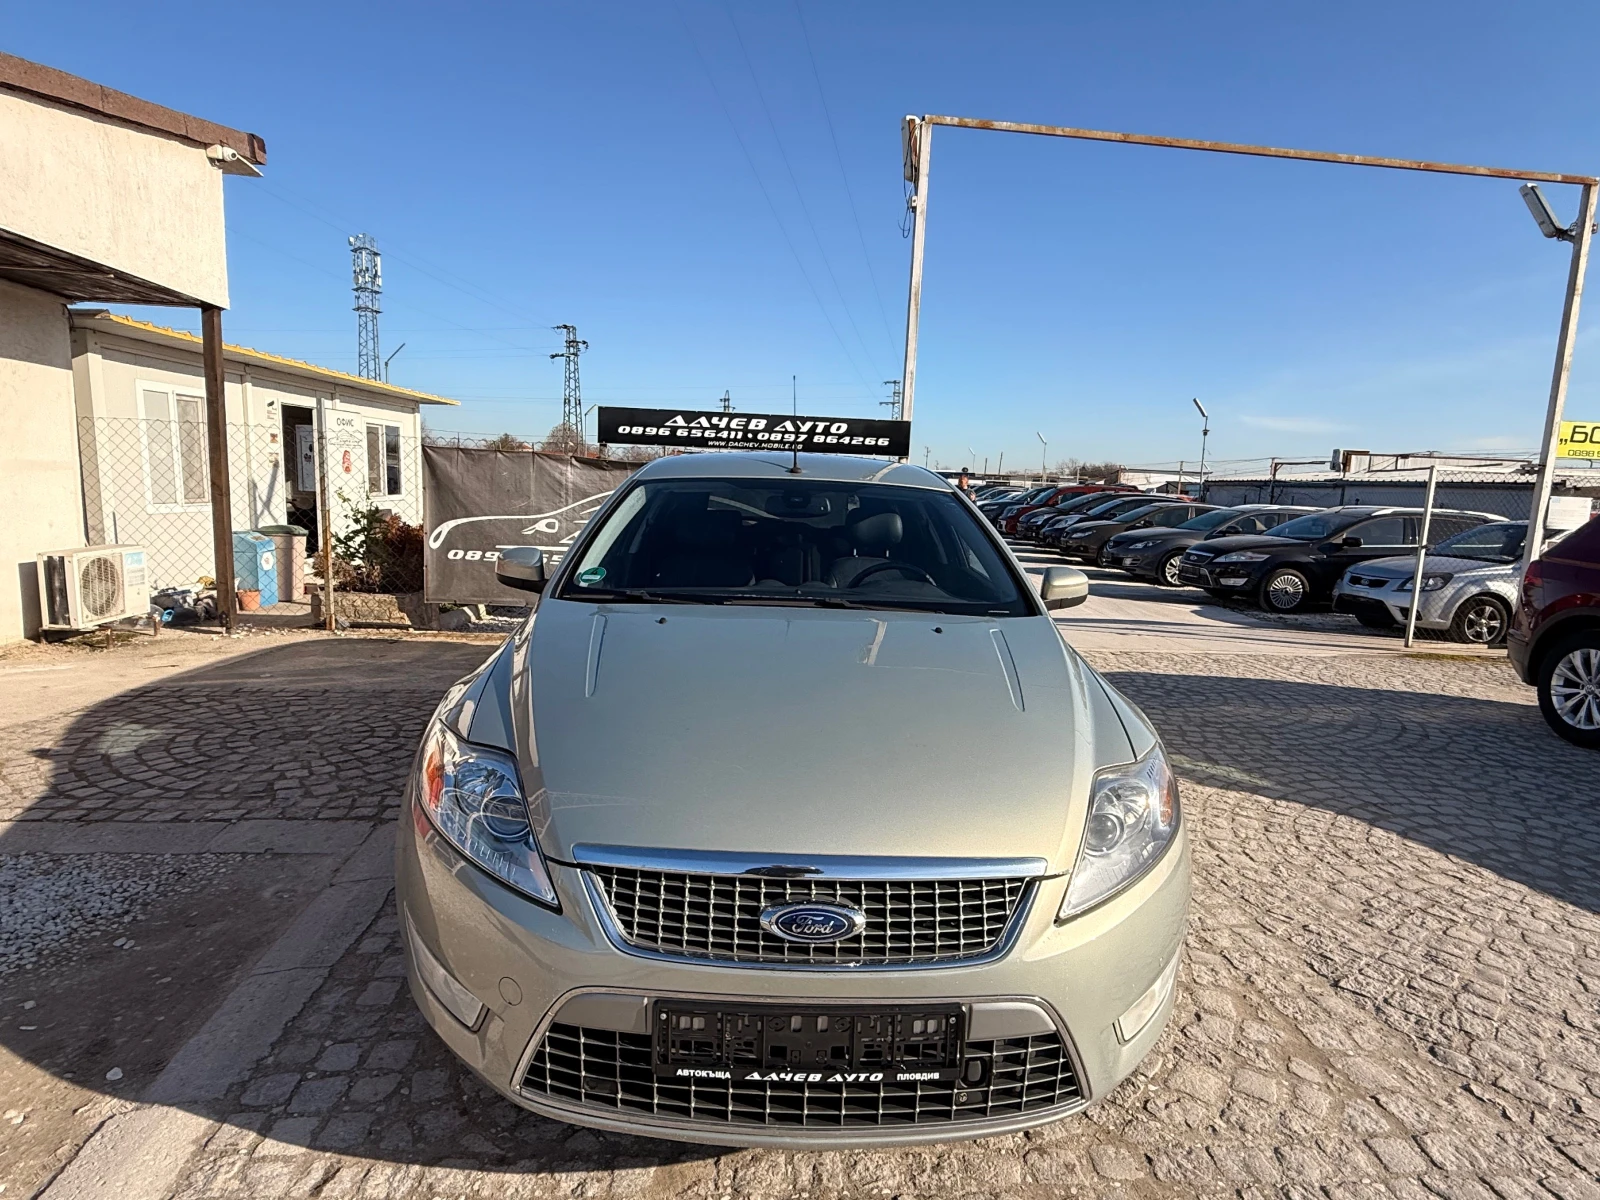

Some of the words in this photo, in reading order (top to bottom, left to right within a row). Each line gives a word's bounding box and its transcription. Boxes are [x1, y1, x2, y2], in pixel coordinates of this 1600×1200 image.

[337, 417, 355, 427] ОФИС
[664, 414, 768, 431] ДАЧЕВ
[773, 419, 849, 434] АУТО
[617, 425, 671, 436] 0896
[676, 428, 743, 440] 656411
[756, 432, 808, 442] 0897
[812, 434, 890, 446] 864266
[447, 549, 501, 562] 089
[791, 914, 835, 934] Ford
[675, 1068, 732, 1079] АВТОКЪЩА
[744, 1071, 823, 1082] ДАЧЕВ
[826, 1072, 884, 1082] АУТО
[896, 1072, 940, 1081] ПЛОВДИВ
